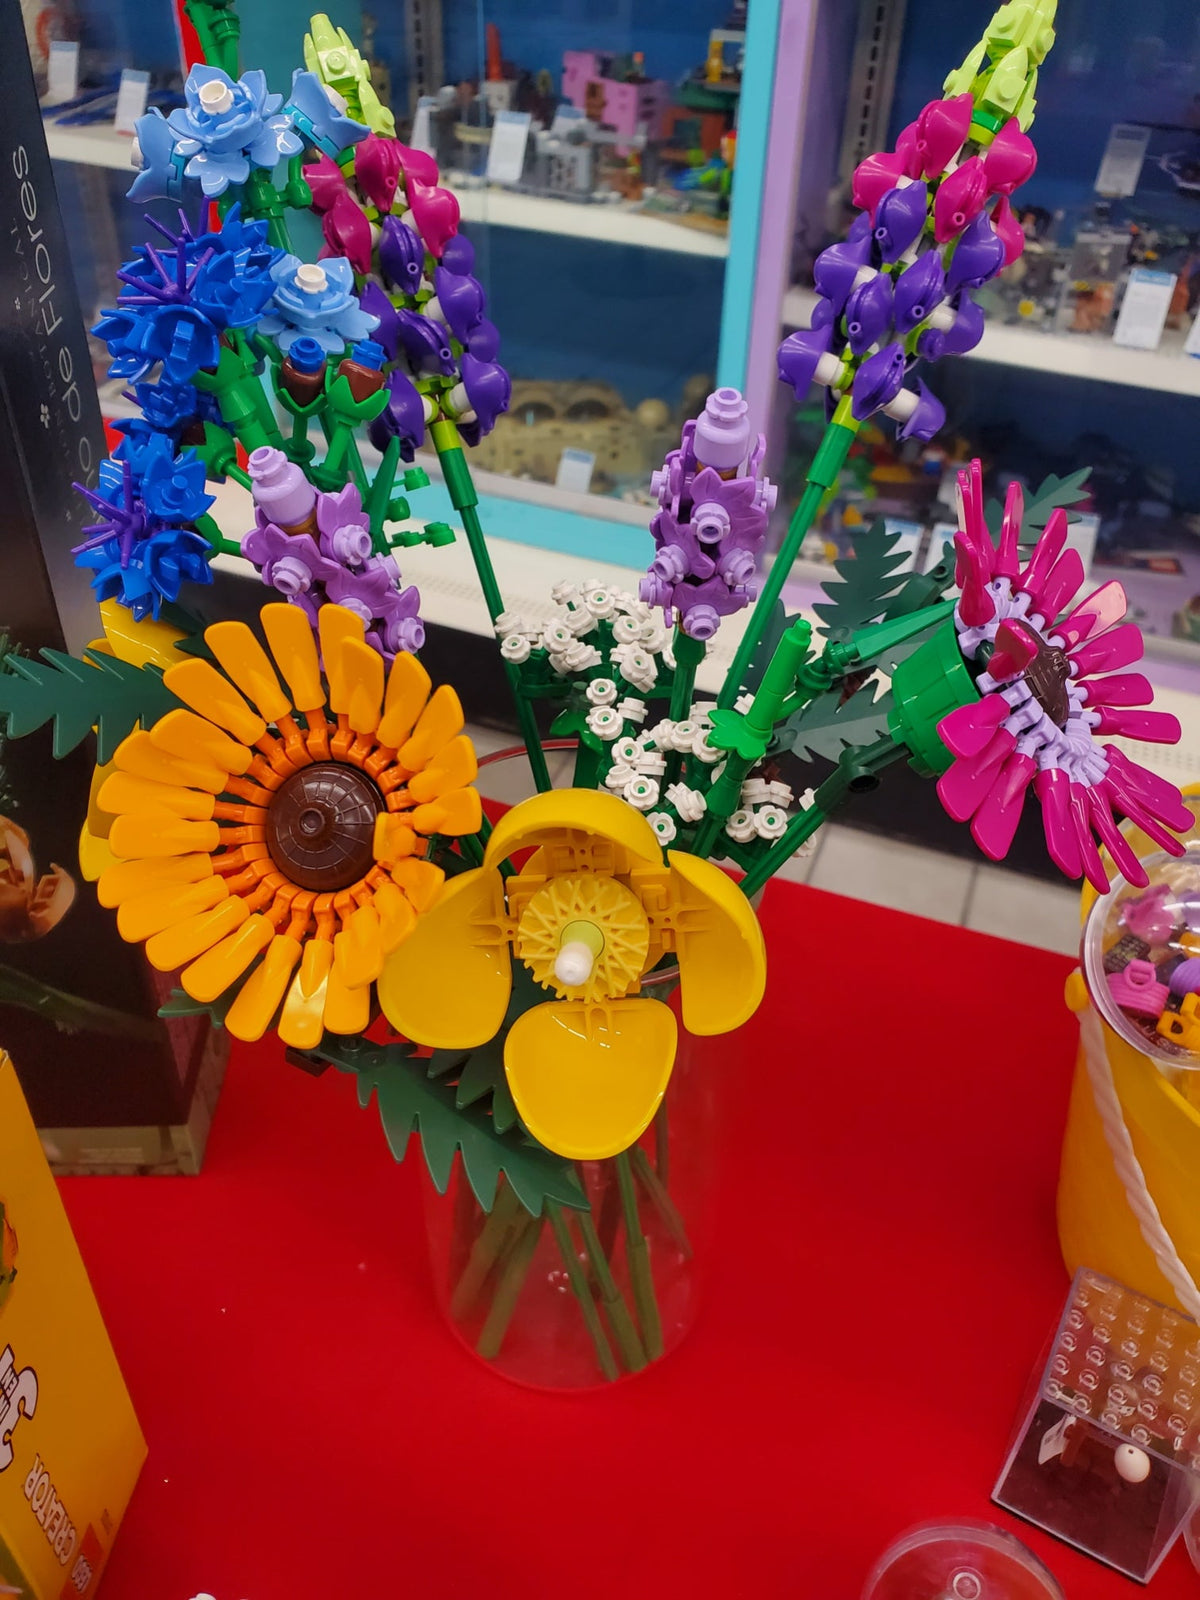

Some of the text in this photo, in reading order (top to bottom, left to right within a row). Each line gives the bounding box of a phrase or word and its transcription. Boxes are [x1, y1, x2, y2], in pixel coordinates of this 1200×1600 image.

[13, 145, 63, 337] Flores
[59, 346, 81, 422] de
[24, 1452, 77, 1567] CREATOR
